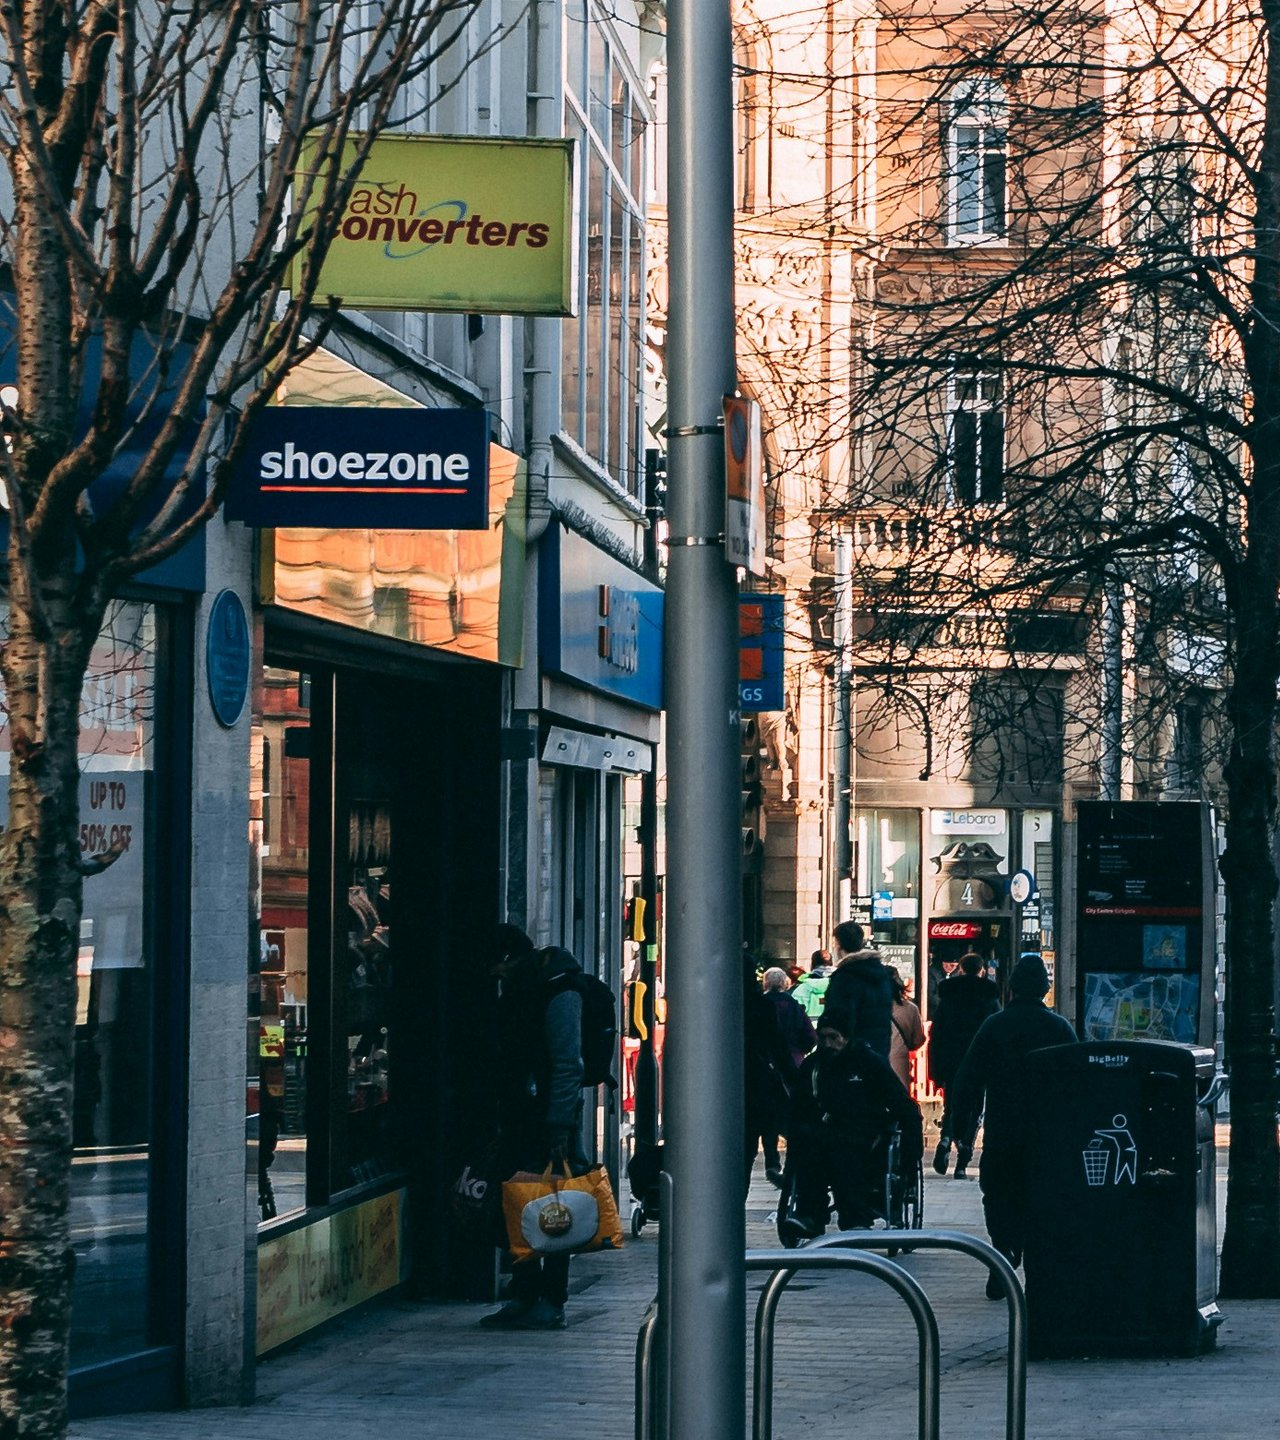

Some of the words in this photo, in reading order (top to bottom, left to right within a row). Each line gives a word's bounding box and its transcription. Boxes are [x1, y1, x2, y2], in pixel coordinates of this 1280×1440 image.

[348, 183, 418, 216] ash
[260, 442, 470, 482] shoezone
[90, 781, 106, 810] UP
[109, 781, 126, 810] TO
[952, 812, 996, 825] Lebara
[80, 823, 107, 852] 50%
[960, 882, 974, 905] 4
[1088, 1055, 1130, 1063] BigBelly
